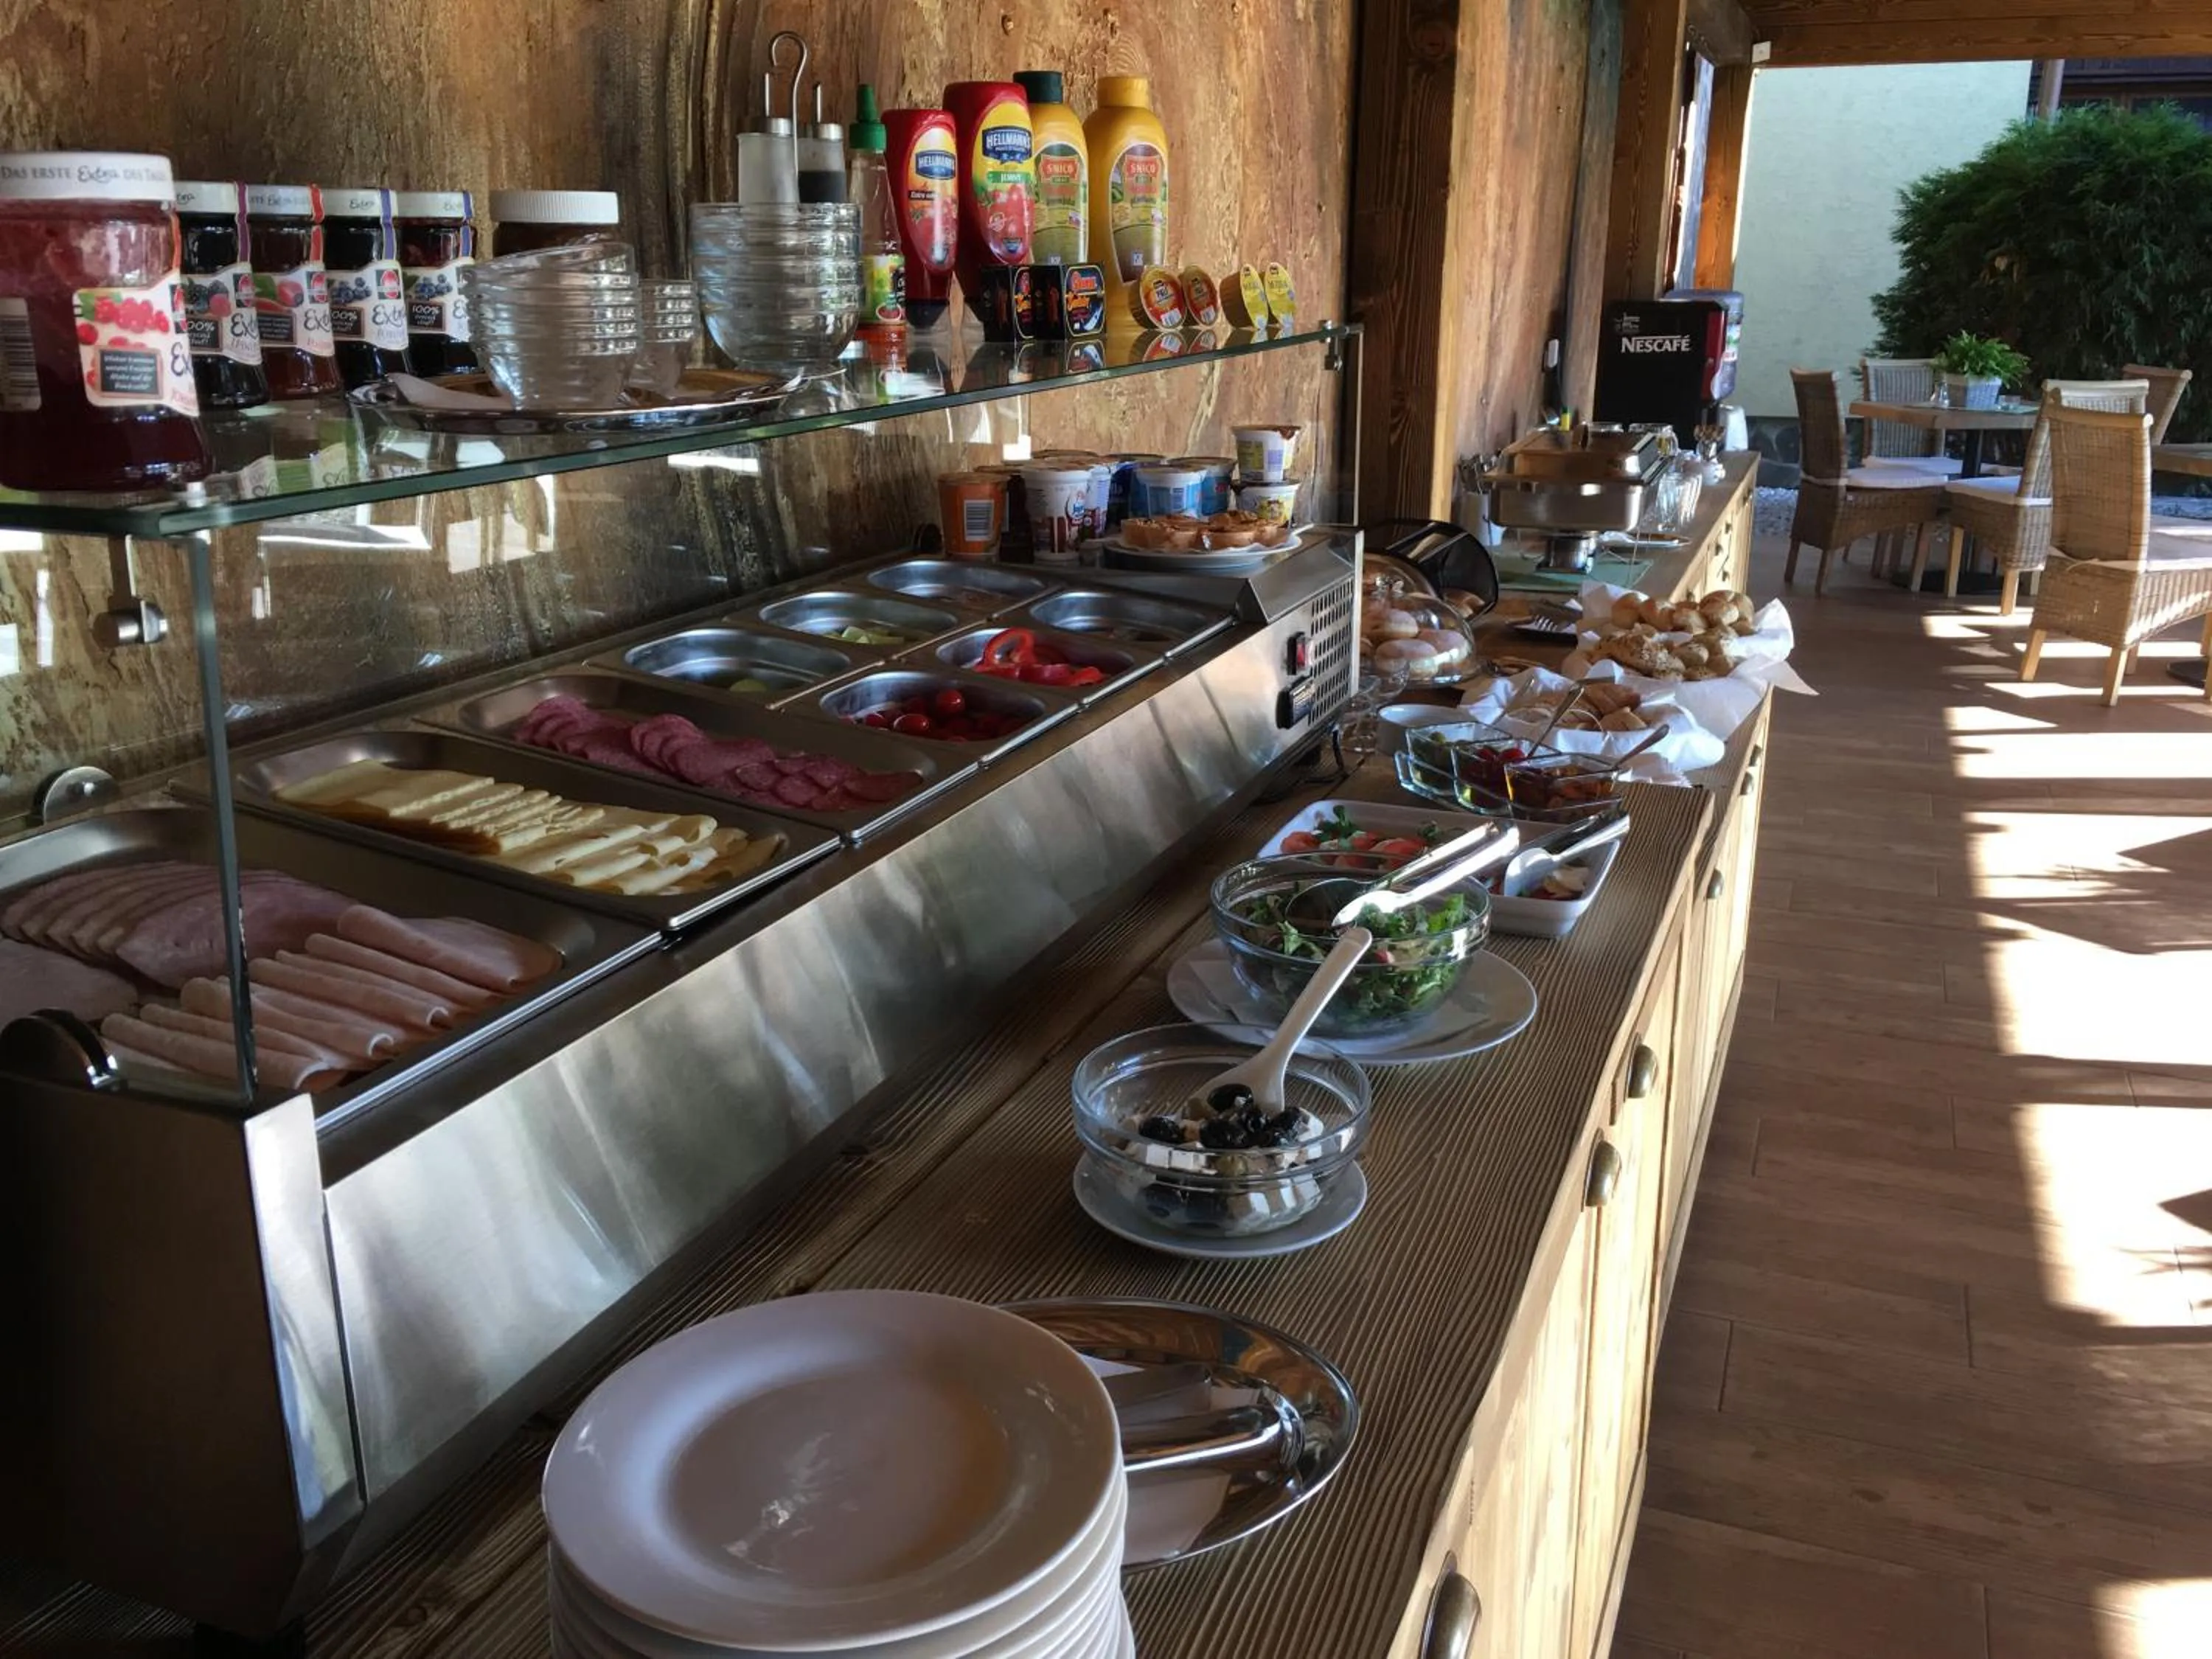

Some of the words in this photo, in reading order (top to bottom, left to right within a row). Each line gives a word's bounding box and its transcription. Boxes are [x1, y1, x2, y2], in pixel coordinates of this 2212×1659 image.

[411, 305, 440, 315] 100%
[331, 310, 358, 321] 00%
[187, 321, 216, 331] 00%
[1621, 334, 1691, 353] NESCAFÉ
